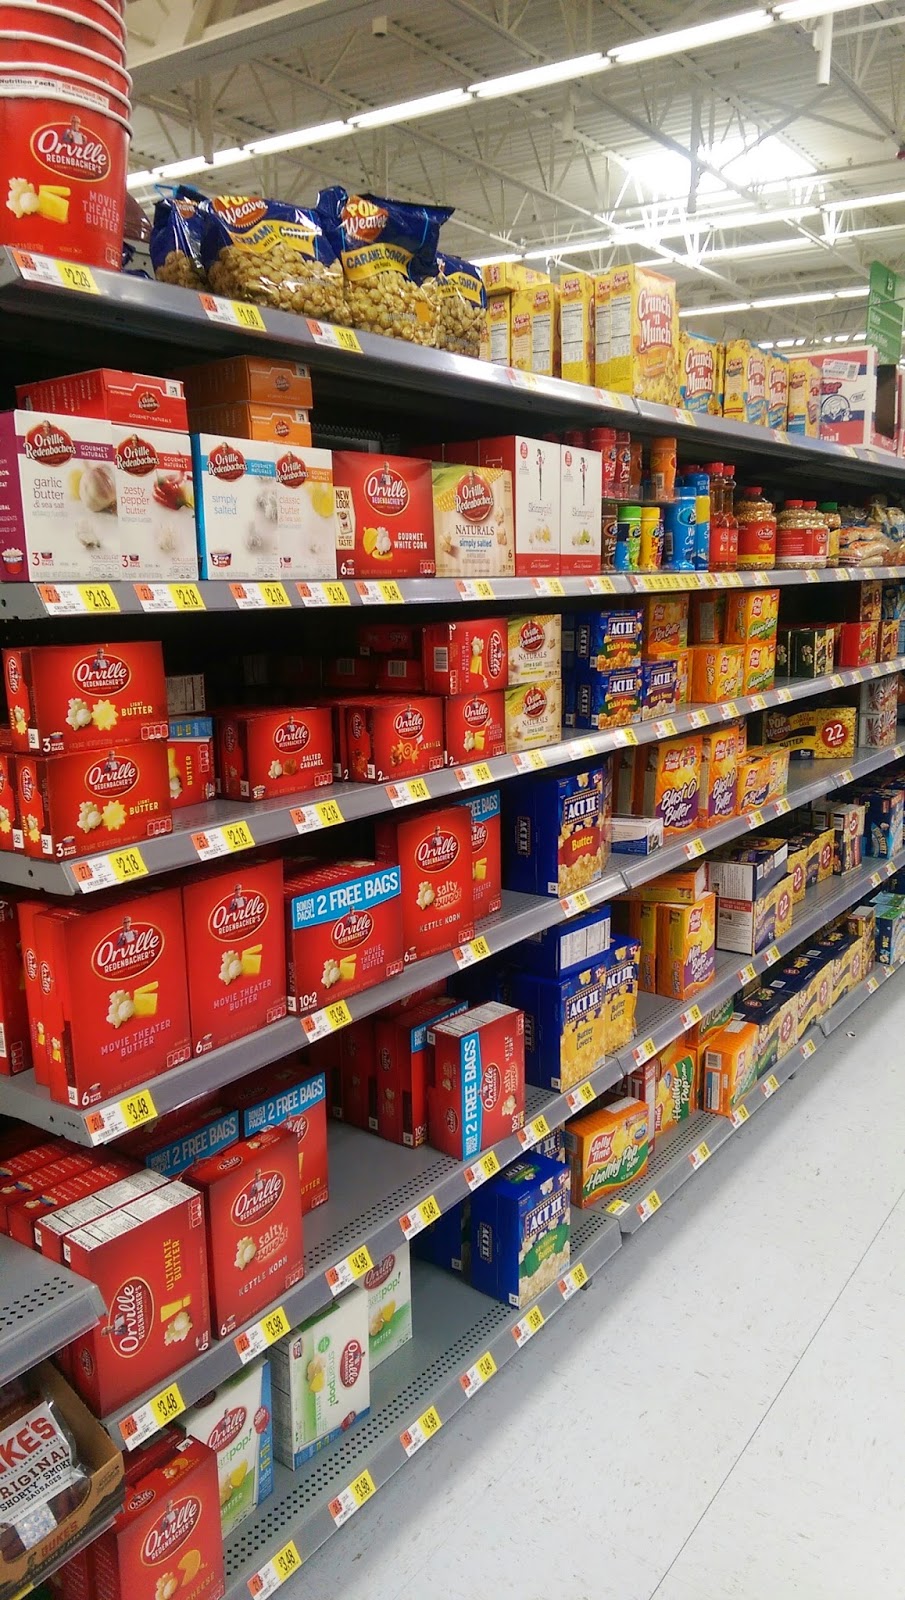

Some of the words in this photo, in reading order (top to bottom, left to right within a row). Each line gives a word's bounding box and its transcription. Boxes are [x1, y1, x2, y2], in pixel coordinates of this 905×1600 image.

[34, 79, 55, 88] Facts
[37, 130, 107, 166] Orville
[46, 154, 102, 174] REDENBACHER'S
[89, 190, 117, 211] MOVIE
[82, 202, 120, 224] THEATER
[86, 215, 118, 234] BUTTER
[346, 250, 384, 269] CARAMEL
[385, 250, 408, 266] CORN
[638, 289, 671, 320] Crunch
[640, 318, 672, 350] Munch
[685, 348, 713, 372] Crunch
[686, 374, 713, 398] Munch
[33, 434, 64, 448] Orville
[80, 445, 109, 454] GOURMET
[123, 446, 150, 459] Orville
[34, 477, 62, 489] garlic
[123, 486, 145, 496] zesty
[367, 477, 407, 497] Orville
[33, 488, 64, 501] butter
[120, 496, 150, 507] pepper
[212, 495, 237, 506] simply
[335, 490, 349, 500] NEW
[126, 506, 146, 515] butter
[214, 505, 237, 515] salted
[335, 499, 349, 509] LOOK
[398, 532, 424, 540] GOURMET
[456, 525, 494, 535] NATURALS
[413, 541, 427, 549] CORN
[459, 538, 476, 549] simply
[477, 539, 492, 548] salted
[87, 590, 111, 607] $2.18
[176, 589, 198, 605] $2.18
[265, 586, 285, 604] $2.18
[611, 623, 625, 634] ACT
[518, 651, 547, 660] NATURALS
[76, 663, 127, 681] Orville
[83, 679, 124, 688] REDENBACHER'S
[612, 682, 625, 692] ACT
[121, 706, 153, 717] BUTTER
[464, 704, 488, 718] Orville
[395, 713, 422, 729] Orville
[522, 716, 548, 726] NATURALS
[769, 717, 786, 728] POP
[275, 727, 307, 743] Orville
[825, 724, 844, 742] 22
[43, 738, 50, 752] 3
[779, 738, 804, 748] BUTTER
[301, 760, 324, 769] CARAMEL
[303, 753, 321, 762] SALTED
[89, 767, 136, 785] Orville
[94, 778, 133, 791] REDENBACHER'S
[482, 795, 498, 814] BAGS
[568, 800, 585, 819] ACT
[586, 797, 596, 814] II
[661, 788, 686, 811] Blast
[129, 803, 158, 815] BUTTER
[664, 804, 691, 828] Butter
[227, 827, 247, 846] $2.18
[571, 836, 594, 851] Butter
[418, 837, 457, 862] Orville
[822, 846, 831, 863] 22
[117, 855, 139, 873] $2.18
[794, 868, 801, 885] 22
[329, 884, 363, 911] FREE
[364, 872, 398, 899] BAGS
[437, 881, 457, 897] salty
[213, 896, 264, 928] Orville
[780, 895, 789, 916] 22
[218, 915, 261, 935] REDENBACHER'S
[334, 915, 371, 940] Orville
[419, 920, 443, 932] KETTLE
[444, 913, 461, 924] KORN
[338, 928, 369, 945] REDENBACHER'S
[97, 928, 159, 967] Orville
[363, 944, 381, 956] MOVIE
[104, 951, 155, 973] REDENBACHER'S
[361, 950, 385, 964] THEATER
[362, 957, 384, 971] BUTTER
[606, 971, 622, 990] ACT
[622, 966, 634, 982] II
[213, 994, 237, 1009] MOVIE
[240, 979, 272, 997] THEATER
[229, 993, 258, 1011] BUTTER
[299, 992, 318, 1007] 10+2
[570, 995, 588, 1017] ACT
[588, 991, 599, 1009] II
[611, 1001, 625, 1013] Butter
[611, 1009, 625, 1021] Lovers
[101, 1039, 129, 1056] MOVIE
[133, 1019, 171, 1041] THEATER
[577, 1027, 593, 1039] Butter
[120, 1036, 155, 1057] BUTTER
[196, 1041, 203, 1054] 6
[577, 1036, 593, 1050] Lovers
[465, 1039, 479, 1083] BAGS
[81, 1092, 89, 1106] 6
[276, 1091, 298, 1114] FREE
[300, 1078, 323, 1105] BAGS
[466, 1083, 478, 1121] FREE
[672, 1077, 681, 1119] Healthy
[681, 1084, 690, 1103] Pop
[127, 1099, 149, 1120] $3.48
[182, 1131, 208, 1161] FREE
[209, 1117, 236, 1145] BAGS
[592, 1136, 610, 1151] Jolly
[592, 1148, 611, 1161] Time
[586, 1157, 621, 1191] Healthy
[622, 1144, 639, 1167] Pop
[234, 1176, 281, 1218] Orville
[530, 1203, 550, 1230] ACT
[259, 1222, 283, 1248] salty
[163, 1239, 174, 1291] ULTIMATE
[173, 1240, 182, 1281] BUTTER
[239, 1272, 266, 1295] KETTLE
[268, 1256, 288, 1274] KORN
[119, 1284, 139, 1351] Orville
[136, 1285, 145, 1340] REDENBACHER'S
[266, 1316, 284, 1337] $3.98
[158, 1393, 177, 1416] $3.48
[0, 1446, 70, 1500] RIGINAL
[25, 1474, 62, 1502] SAUSAGES
[145, 1501, 198, 1557] Orville
[151, 1519, 195, 1561] REDENBACHER'S
[278, 1549, 296, 1570] $3.48
